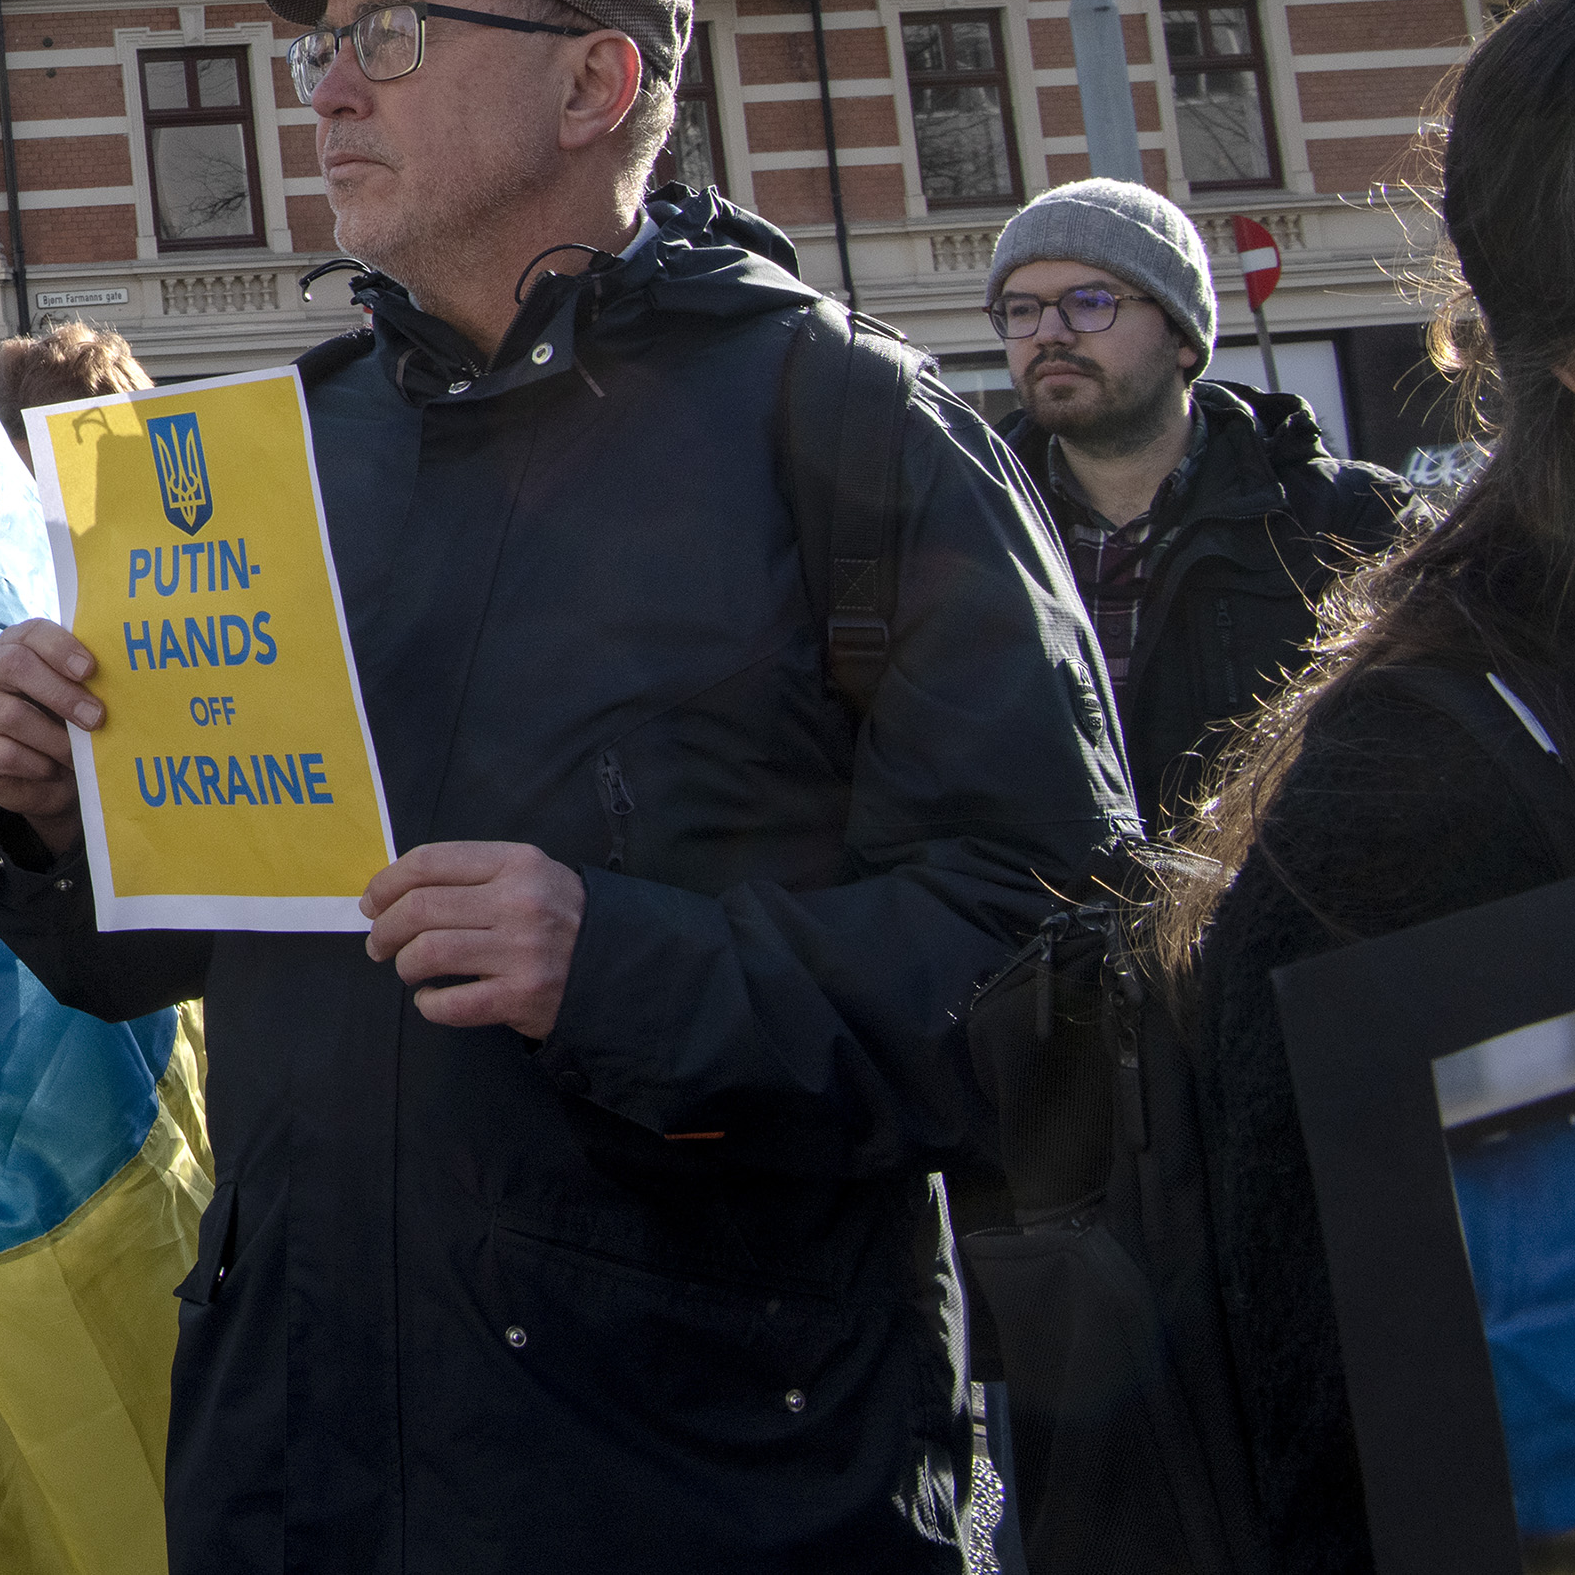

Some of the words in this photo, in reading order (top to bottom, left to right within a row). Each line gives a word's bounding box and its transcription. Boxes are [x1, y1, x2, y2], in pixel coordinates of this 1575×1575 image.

[66, 293, 103, 303] Farmanns
[105, 291, 122, 302] gate
[127, 537, 261, 598] PUTIN-
[123, 610, 278, 671] HANDS
[189, 695, 236, 727] OFF
[134, 752, 334, 808] UKRAINE
